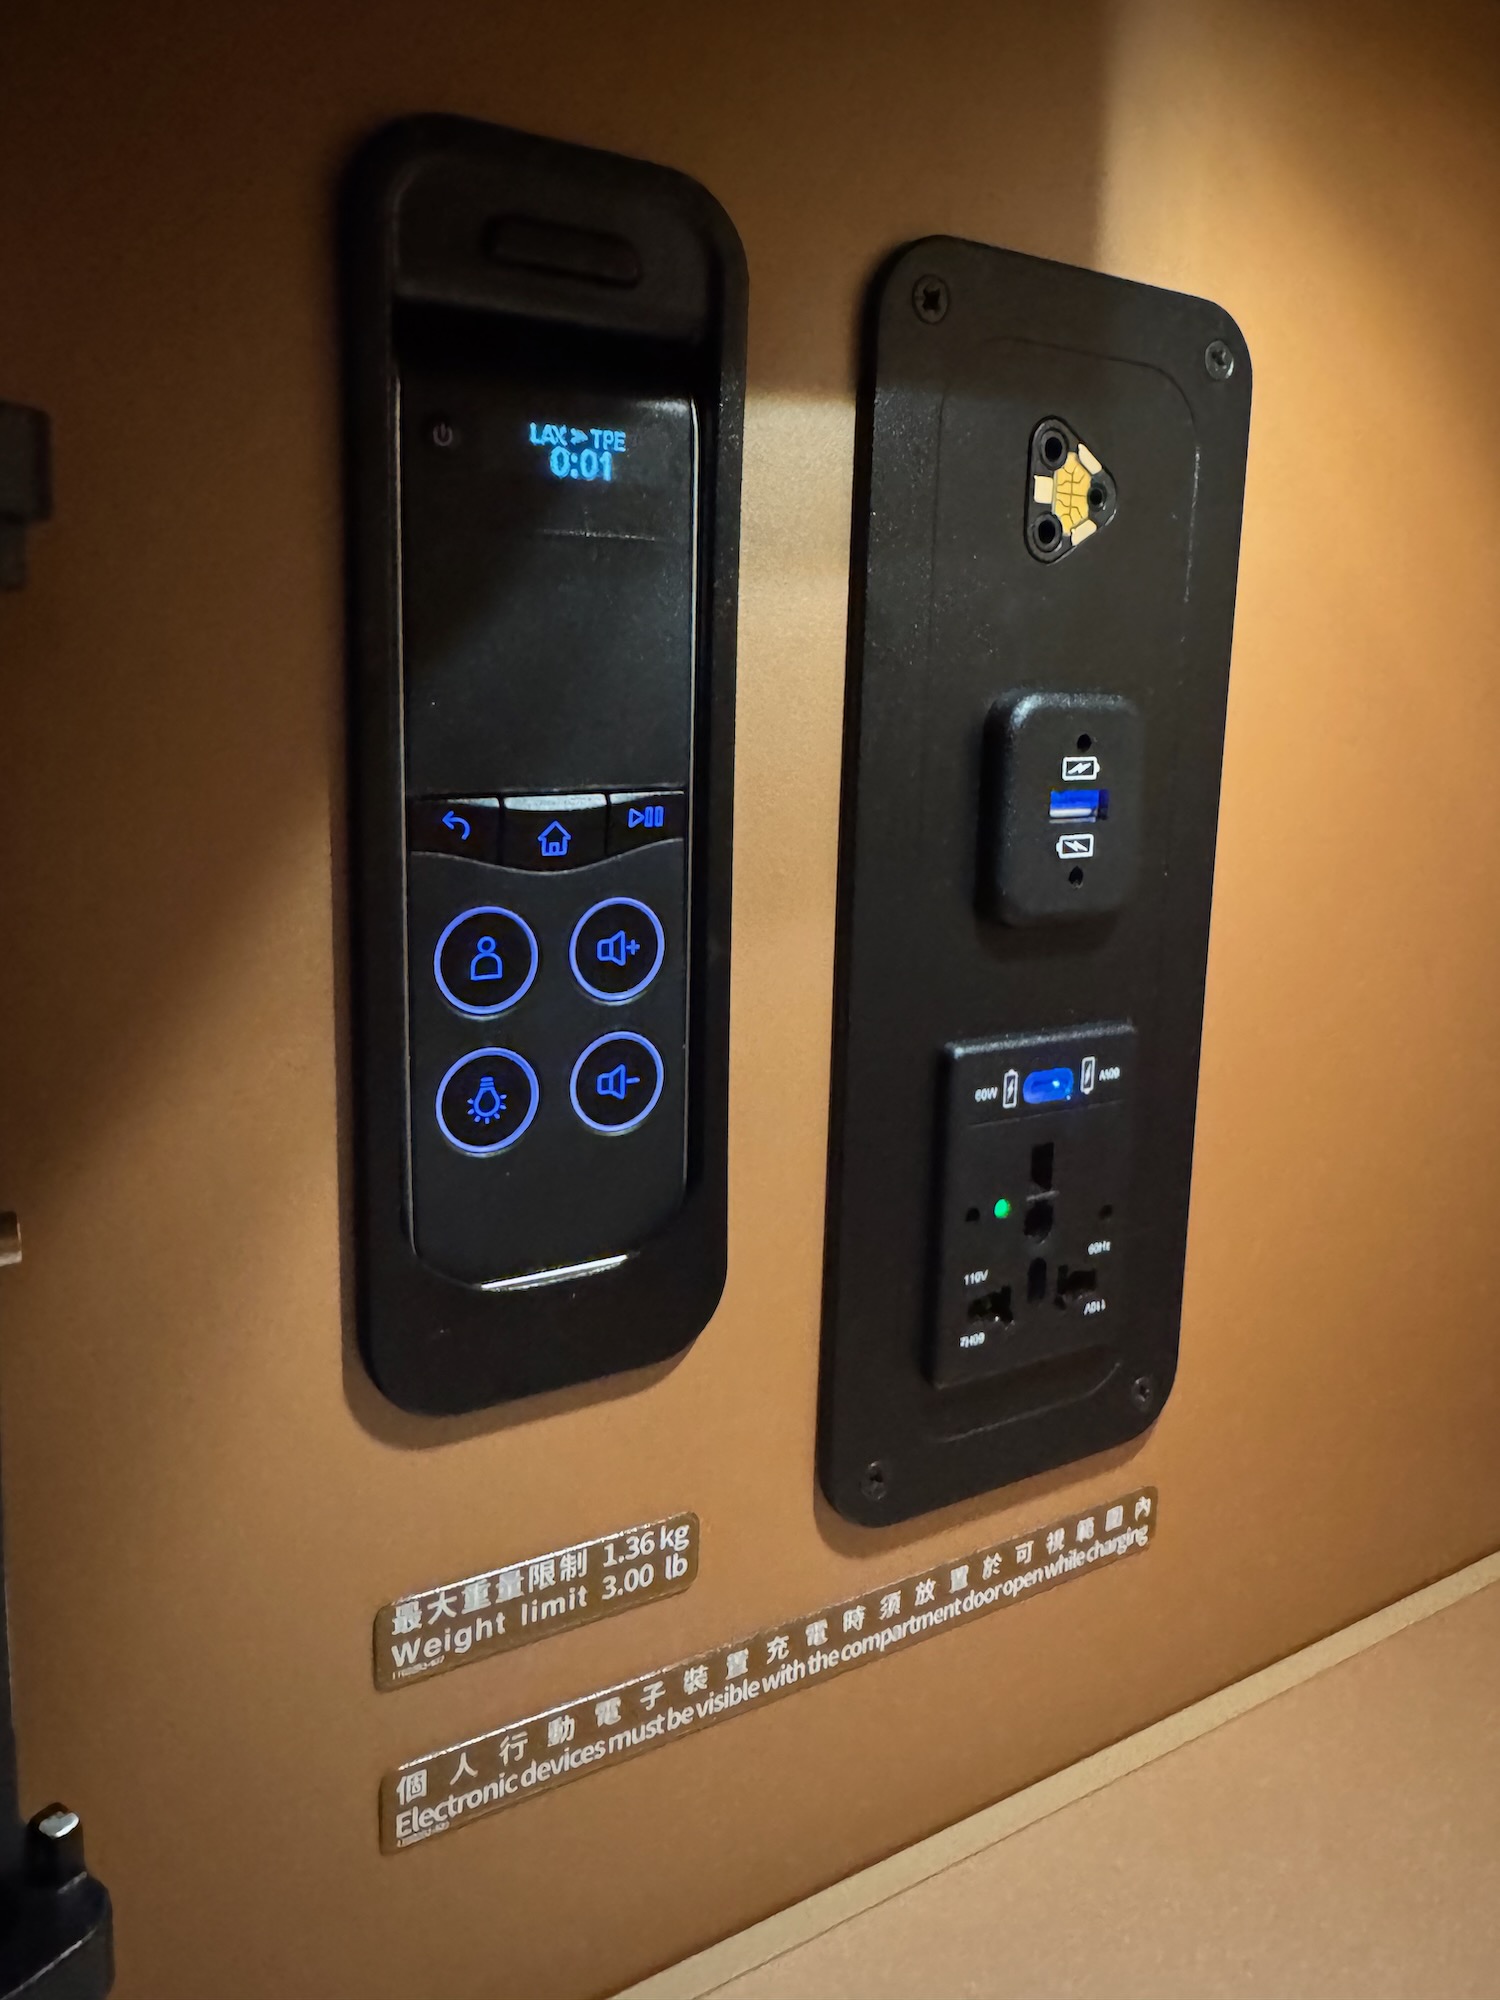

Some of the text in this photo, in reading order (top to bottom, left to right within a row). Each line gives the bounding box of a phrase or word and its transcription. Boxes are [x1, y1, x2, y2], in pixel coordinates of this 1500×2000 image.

[529, 422, 626, 452] LAX TPE
[549, 446, 612, 482] 0:01
[975, 1087, 998, 1102] 60W
[964, 1269, 989, 1286] 110V
[391, 1524, 690, 1636] 最大重量限制 1.36 kg
[390, 1611, 506, 1668] Weight
[521, 1584, 588, 1626] limit
[602, 1562, 655, 1601] 3.00
[664, 1552, 689, 1580] lb
[395, 1771, 519, 1839] Electronic
[520, 1739, 606, 1788] devices
[608, 1712, 666, 1755] must
[667, 1705, 695, 1732] be
[695, 1679, 761, 1719] visible
[761, 1658, 806, 1694] with
[807, 1649, 840, 1676] the
[840, 1597, 962, 1663] compartment
[962, 1582, 1004, 1613] door
[1003, 1566, 1045, 1598] open
[1044, 1548, 1086, 1580] while
[1086, 1524, 1149, 1563] charging
